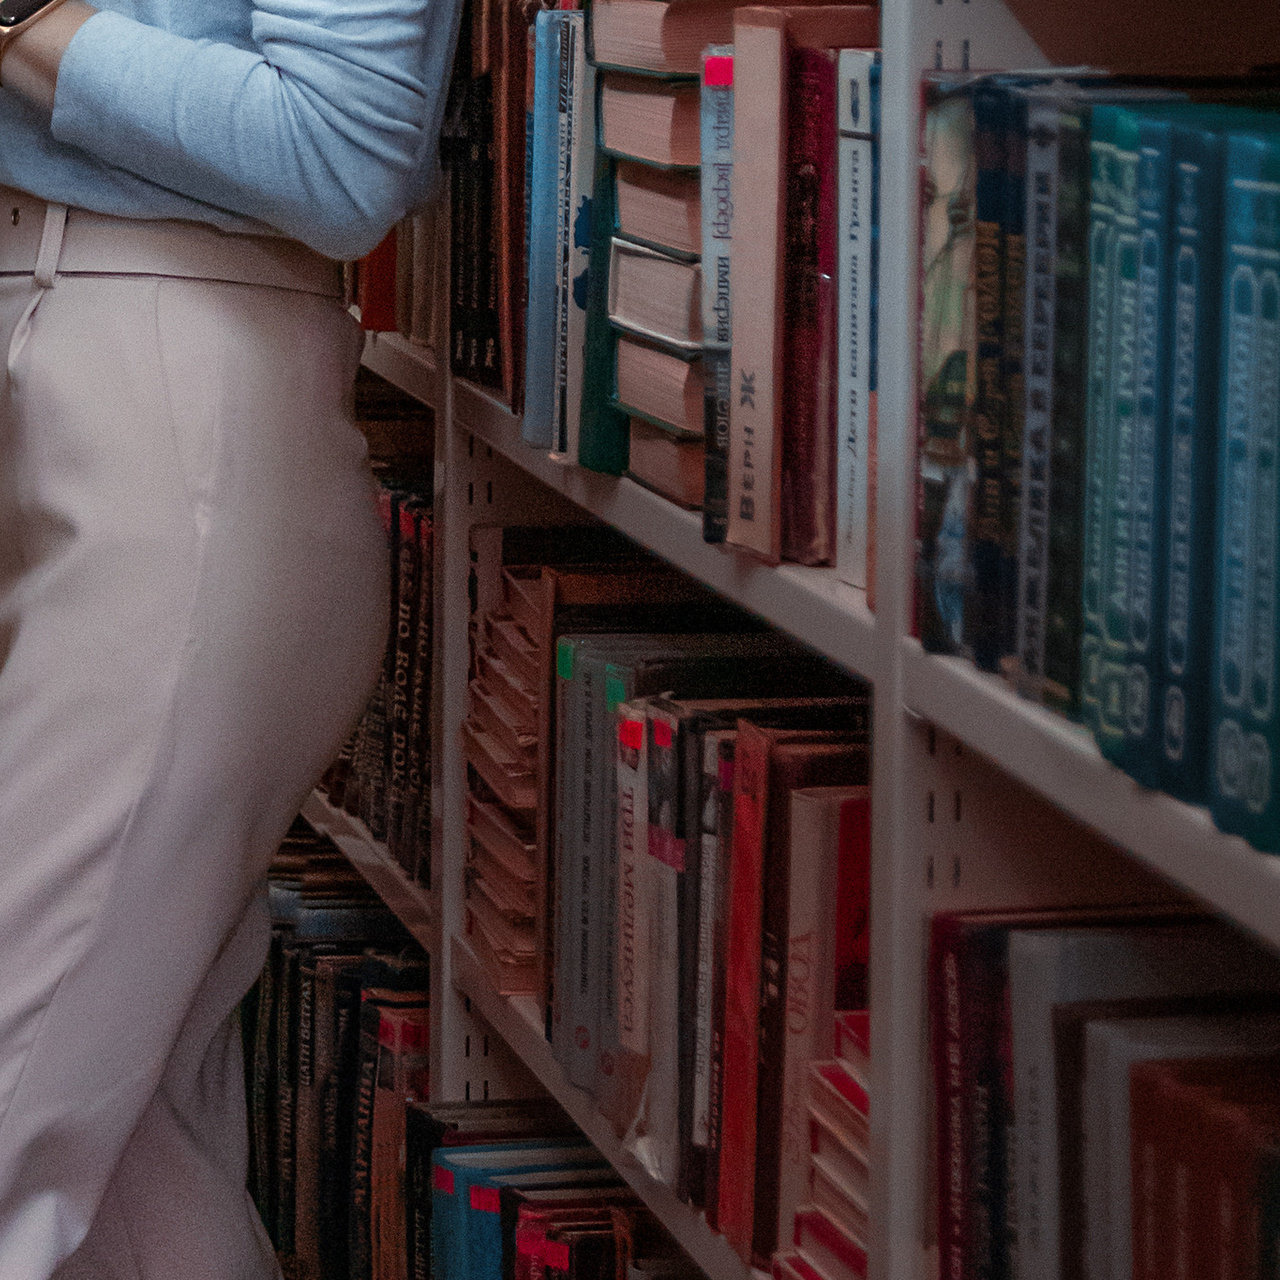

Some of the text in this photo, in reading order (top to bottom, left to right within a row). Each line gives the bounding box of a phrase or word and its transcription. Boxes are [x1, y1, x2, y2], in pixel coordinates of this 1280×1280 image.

[844, 148, 865, 459] Дети капитана Гранта
